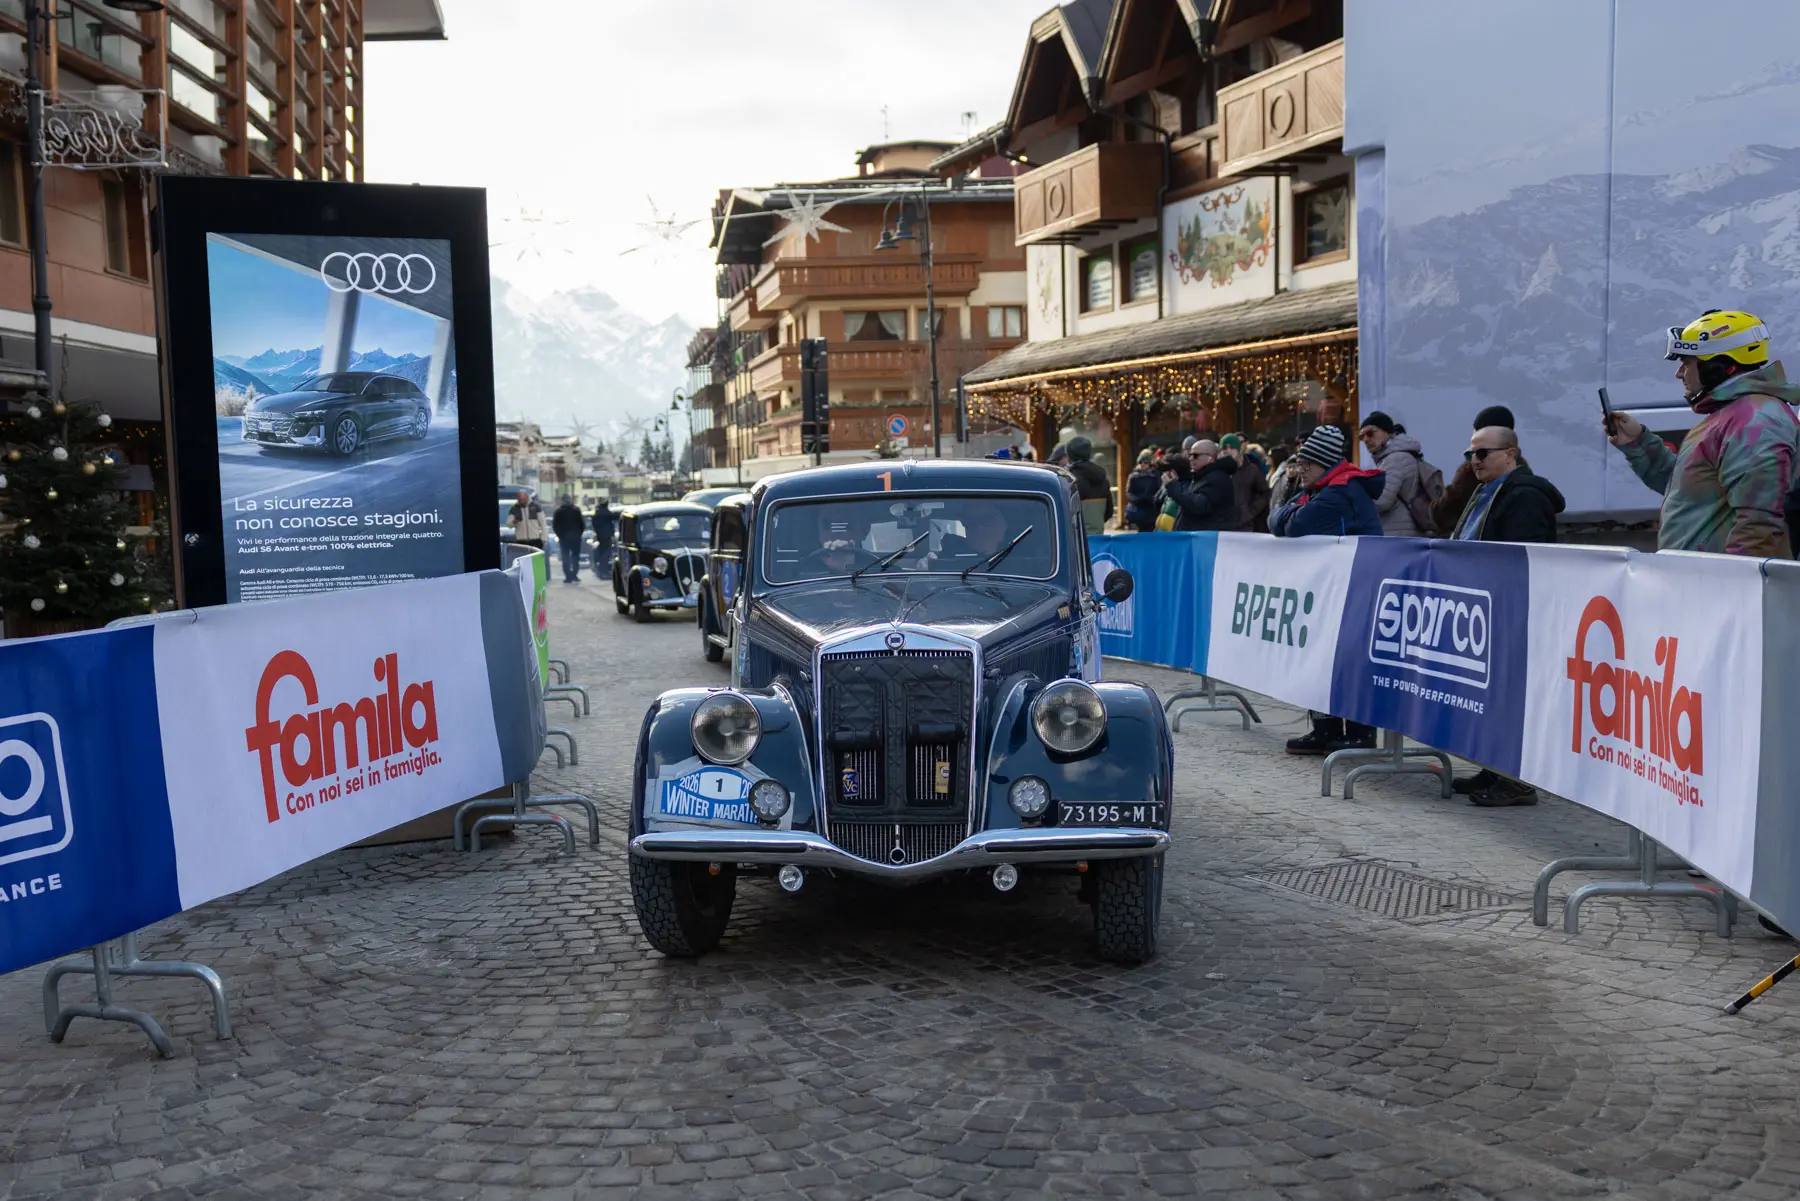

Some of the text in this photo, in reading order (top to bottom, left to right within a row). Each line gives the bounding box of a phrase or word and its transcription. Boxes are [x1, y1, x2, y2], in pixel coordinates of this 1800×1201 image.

[876, 472, 892, 491] 1
[234, 496, 353, 511] La sicurezza
[236, 509, 443, 530] non conosce stagioni.
[264, 536, 318, 546] performance
[376, 532, 411, 541] integrale
[1379, 592, 1486, 658] sparco
[1373, 676, 1390, 688] THE
[1420, 688, 1484, 714] PERFORMANCE
[1567, 595, 1703, 776] famila
[246, 650, 438, 824] famila
[286, 748, 442, 815] Con noi sei in famiglia.
[680, 773, 700, 794] 2026
[716, 778, 724, 793] 1
[1589, 736, 1704, 808] Con noi sei in famiglia.
[666, 781, 710, 817] WINTER
[1063, 806, 1120, 822] 73195
